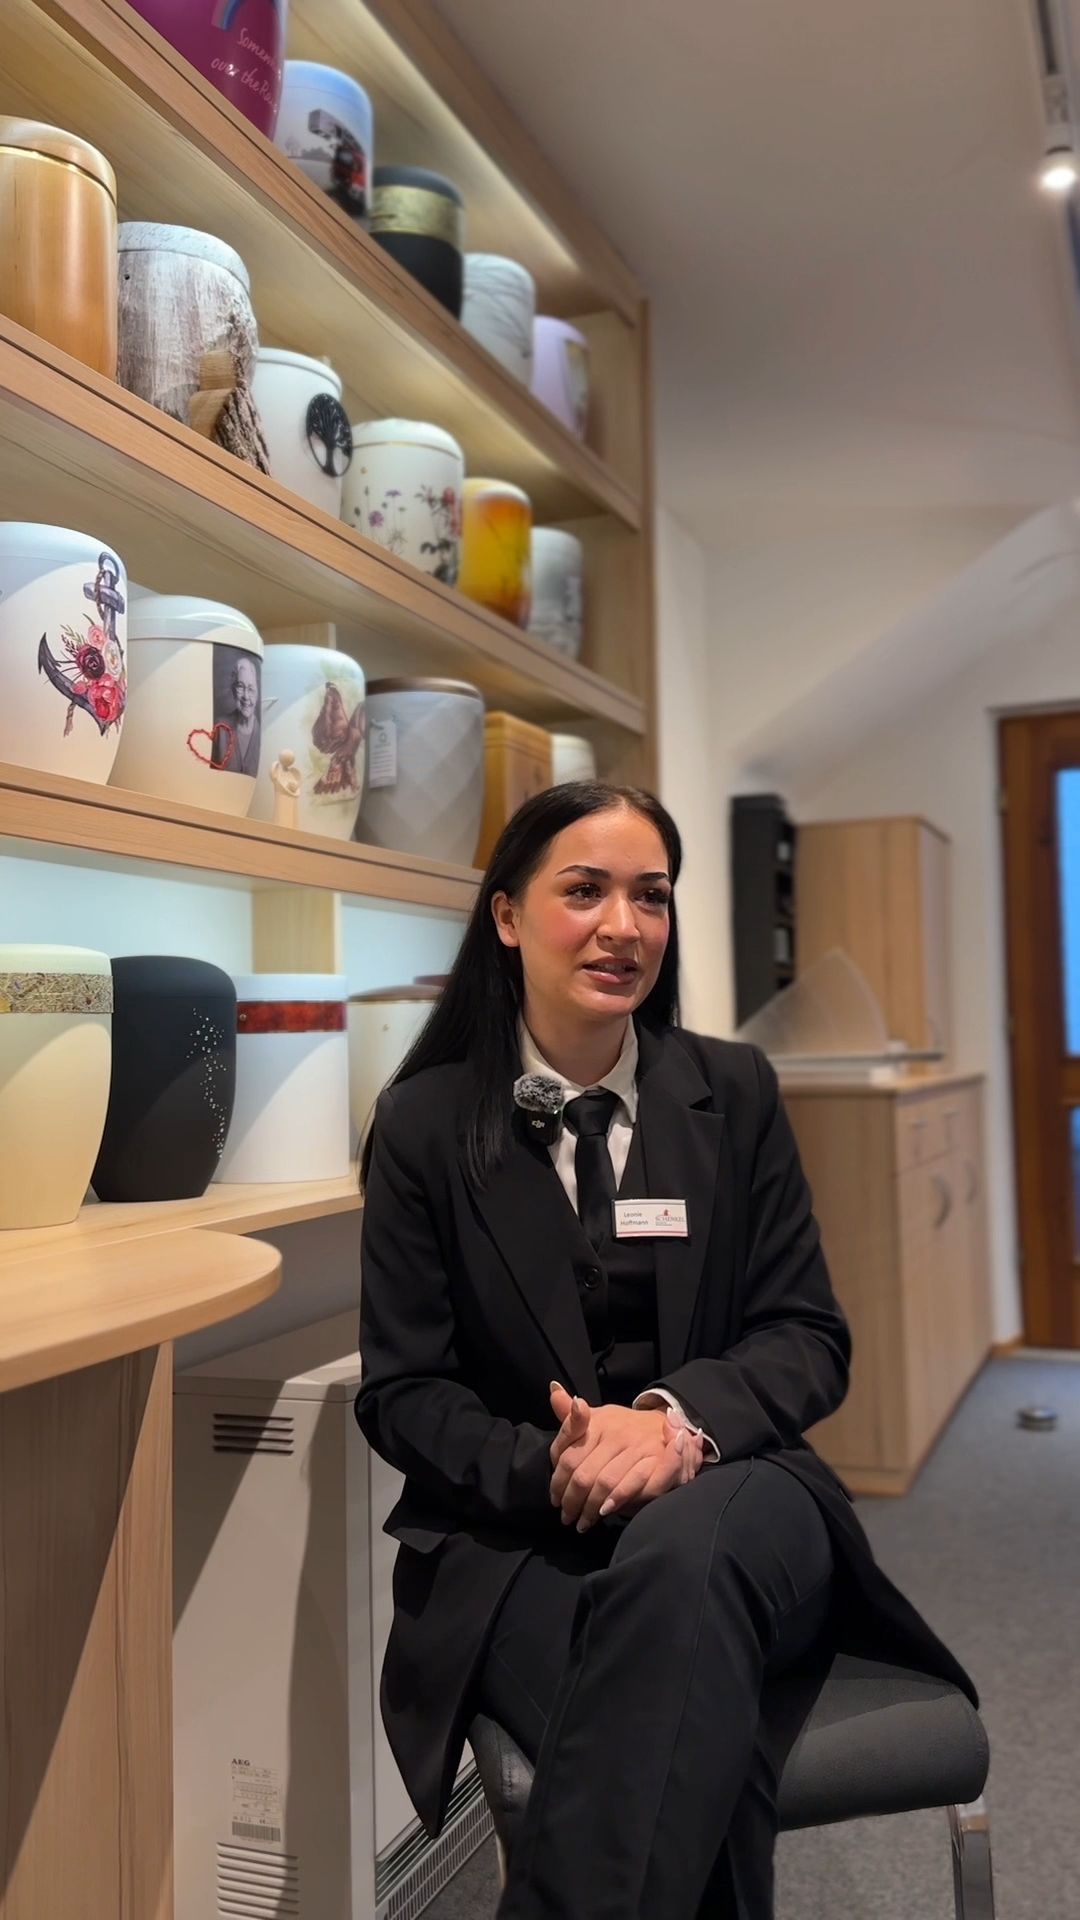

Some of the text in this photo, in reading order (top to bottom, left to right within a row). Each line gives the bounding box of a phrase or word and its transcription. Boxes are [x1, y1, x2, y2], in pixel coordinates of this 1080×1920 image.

[210, 57, 240, 77] over
[240, 67, 259, 92] the
[231, 1758, 250, 1766] AEG
